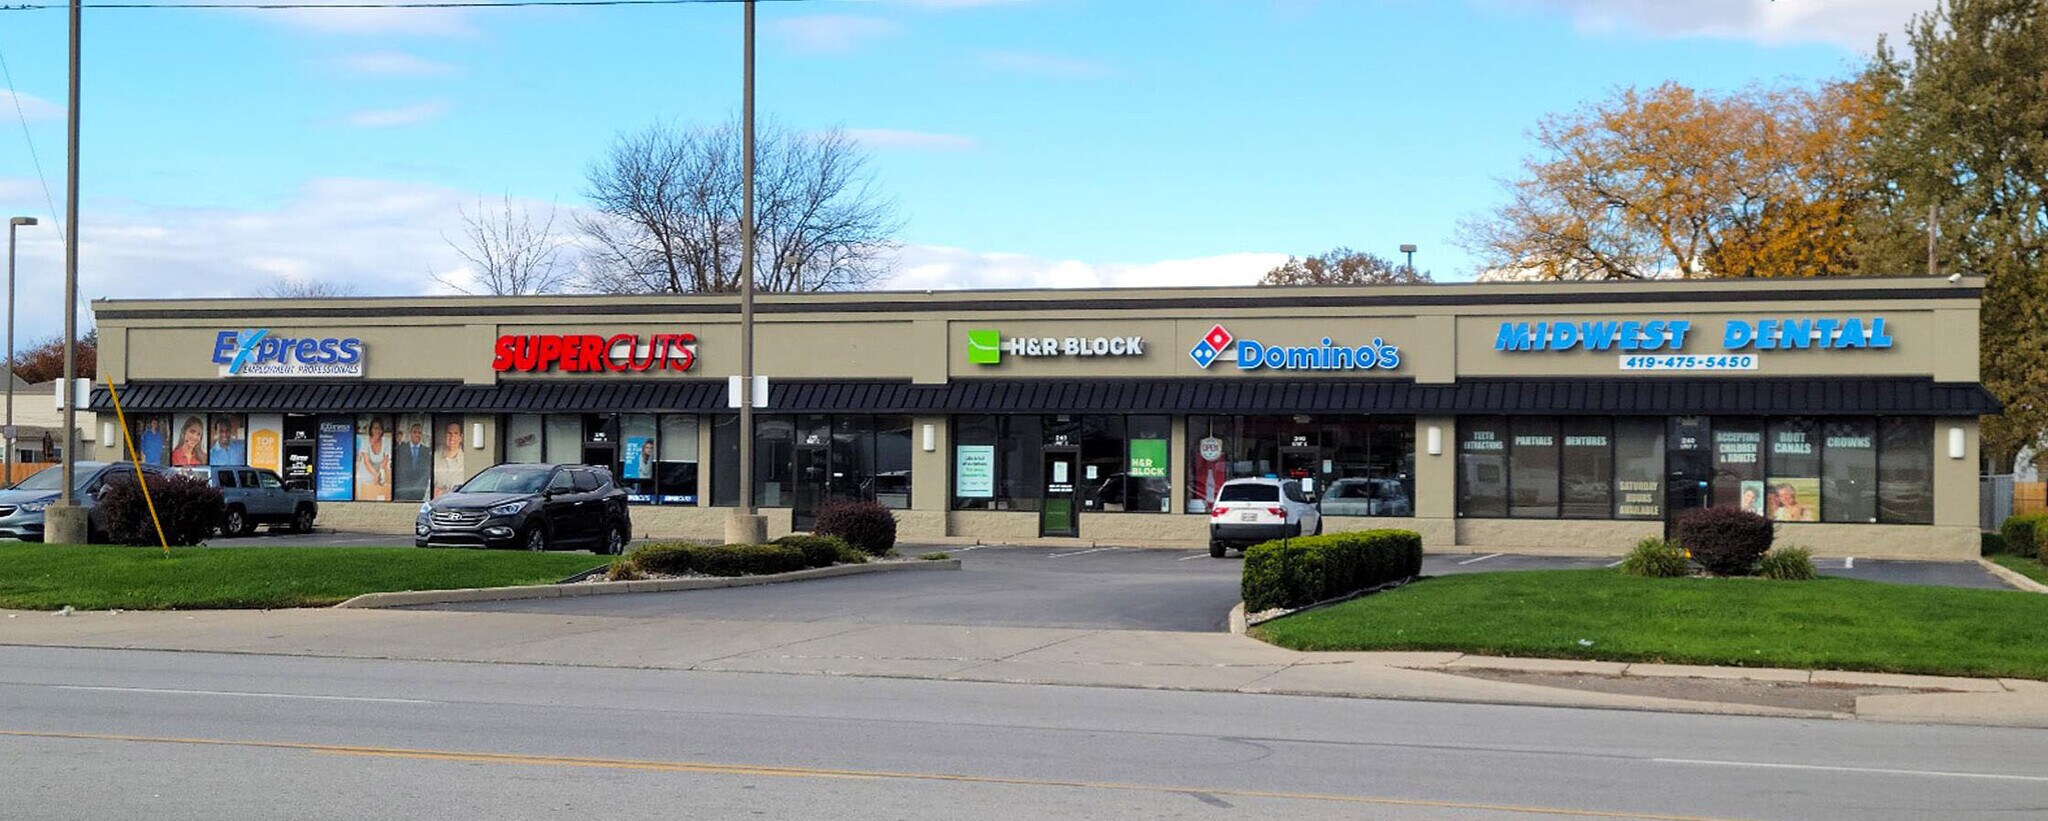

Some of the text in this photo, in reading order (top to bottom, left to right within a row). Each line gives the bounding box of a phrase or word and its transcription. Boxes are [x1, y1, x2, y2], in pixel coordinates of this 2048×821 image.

[1495, 317, 1893, 351] MIDWEST DENTAL
[211, 328, 360, 374] Express
[1010, 336, 1143, 356] H&R BLOCK
[492, 333, 695, 372] SUPERCUTS
[1237, 337, 1400, 370] Domino's
[1626, 356, 1751, 368] 419-475-5450
[242, 365, 359, 374] EMPLOYMENT PROFESSIONALS
[1515, 436, 1553, 446] PARTIALS
[1565, 436, 1607, 446] DENTURES
[1717, 432, 1760, 442] ACCEPTING
[1780, 432, 1806, 442] ROOT
[1827, 437, 1871, 447] CROWNS
[1719, 443, 1757, 453] CHILDREN
[1774, 443, 1812, 454] CANALS
[1132, 458, 1153, 467] H&R
[1728, 453, 1757, 463] ADULTS
[1132, 467, 1165, 475] BLOCK
[1620, 481, 1658, 490] SATURDAY
[1620, 505, 1660, 515] AVAILABLE
